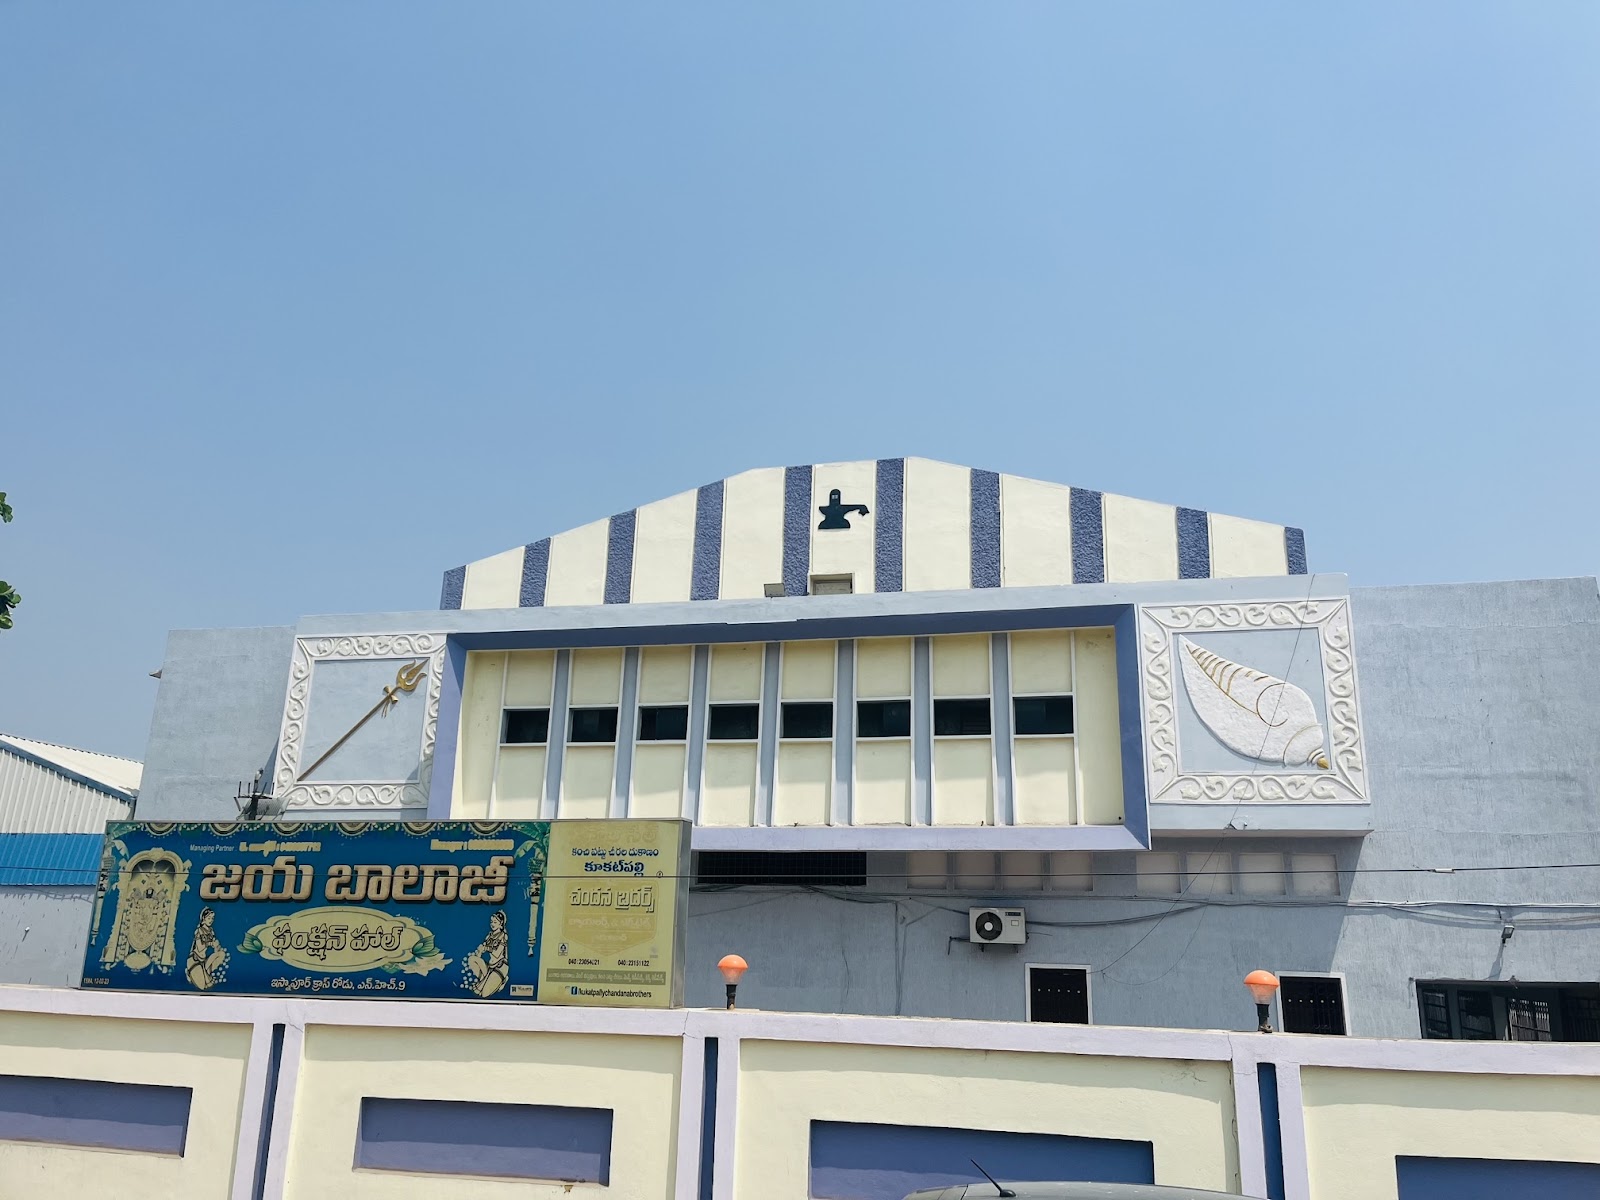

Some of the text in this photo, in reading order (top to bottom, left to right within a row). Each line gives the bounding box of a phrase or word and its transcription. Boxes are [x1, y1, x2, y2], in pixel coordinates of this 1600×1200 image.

[190, 844, 214, 853] Managing
[215, 844, 235, 852] Partner
[200, 855, 515, 902] జయ బాలాజీ
[570, 887, 613, 906] చందన
[271, 923, 404, 961] ఫంక్షన్ హాల్
[312, 977, 331, 992] క్రాస్
